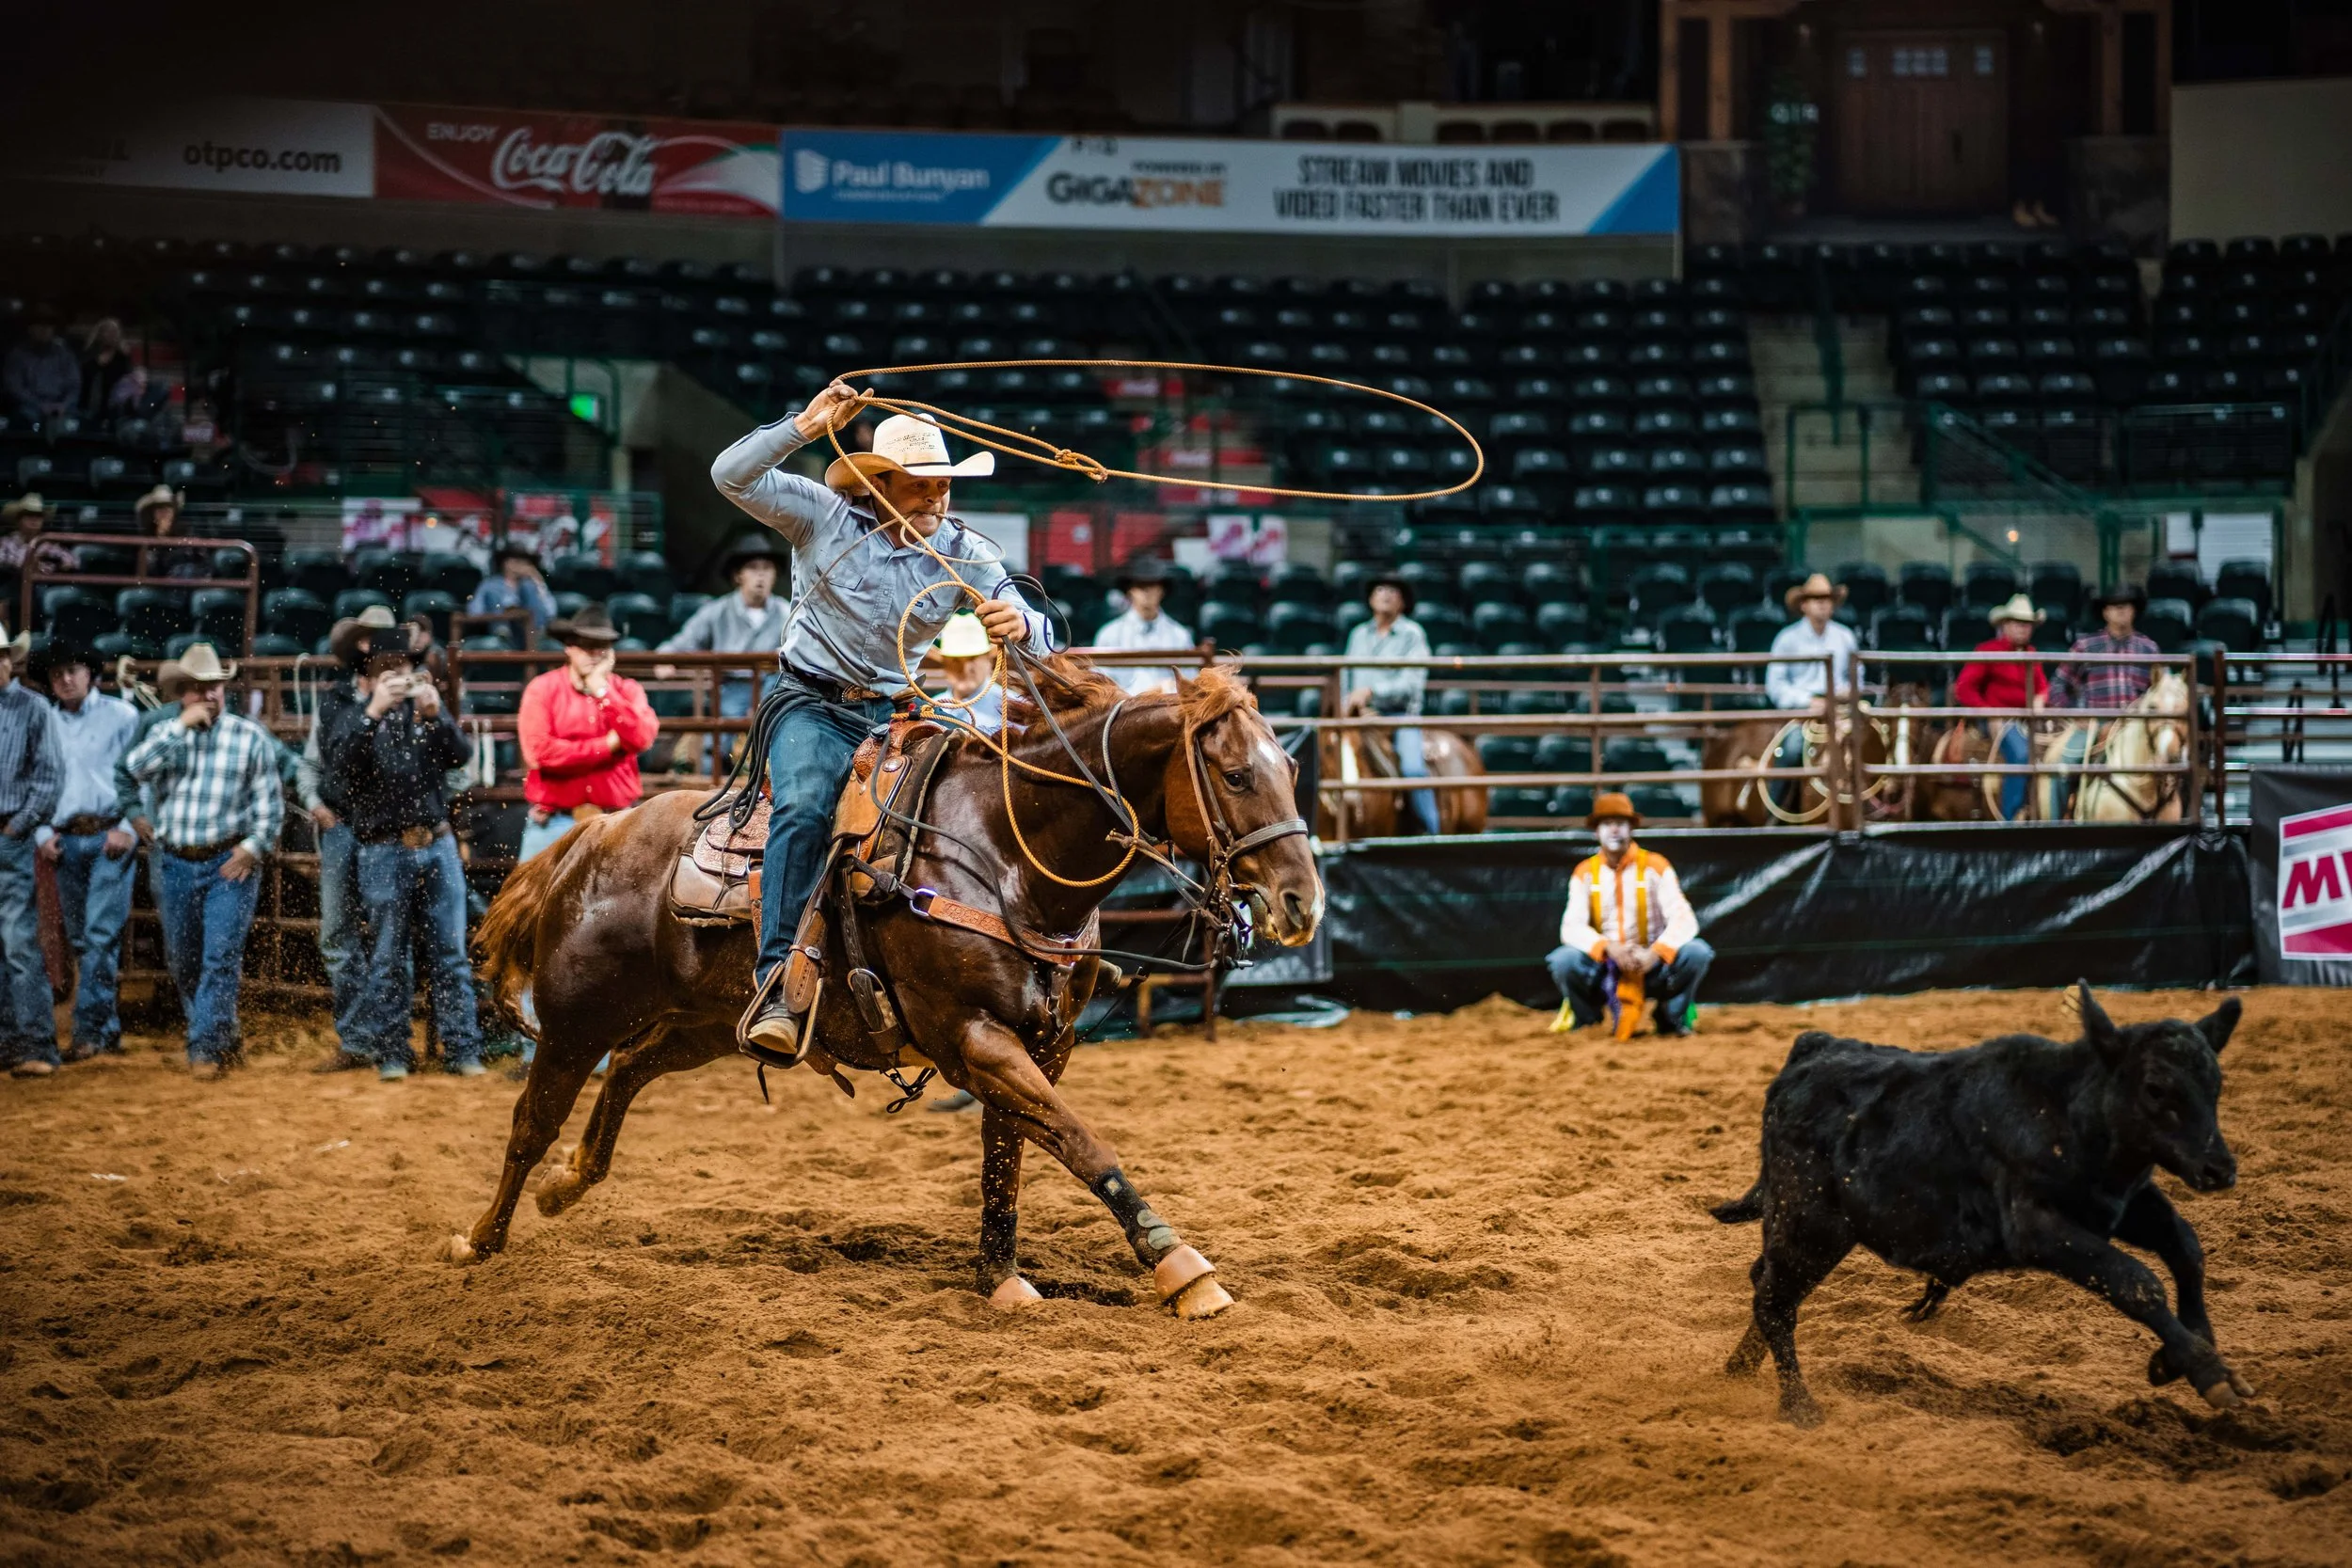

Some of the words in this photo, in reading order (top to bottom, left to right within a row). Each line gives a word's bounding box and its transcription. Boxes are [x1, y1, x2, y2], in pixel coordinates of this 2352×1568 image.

[425, 121, 500, 143] ENJOY
[183, 139, 342, 174] otpco.com
[1298, 153, 1391, 186] STREAM
[1396, 157, 1479, 187] MOVIES
[1486, 157, 1535, 187] AND
[831, 158, 890, 188] Paul
[892, 160, 992, 196] Bunyan
[1272, 186, 1339, 219] VIDEO
[1343, 189, 1425, 221] FASTER
[1432, 190, 1493, 222] THAN
[1498, 190, 1560, 223] EVER
